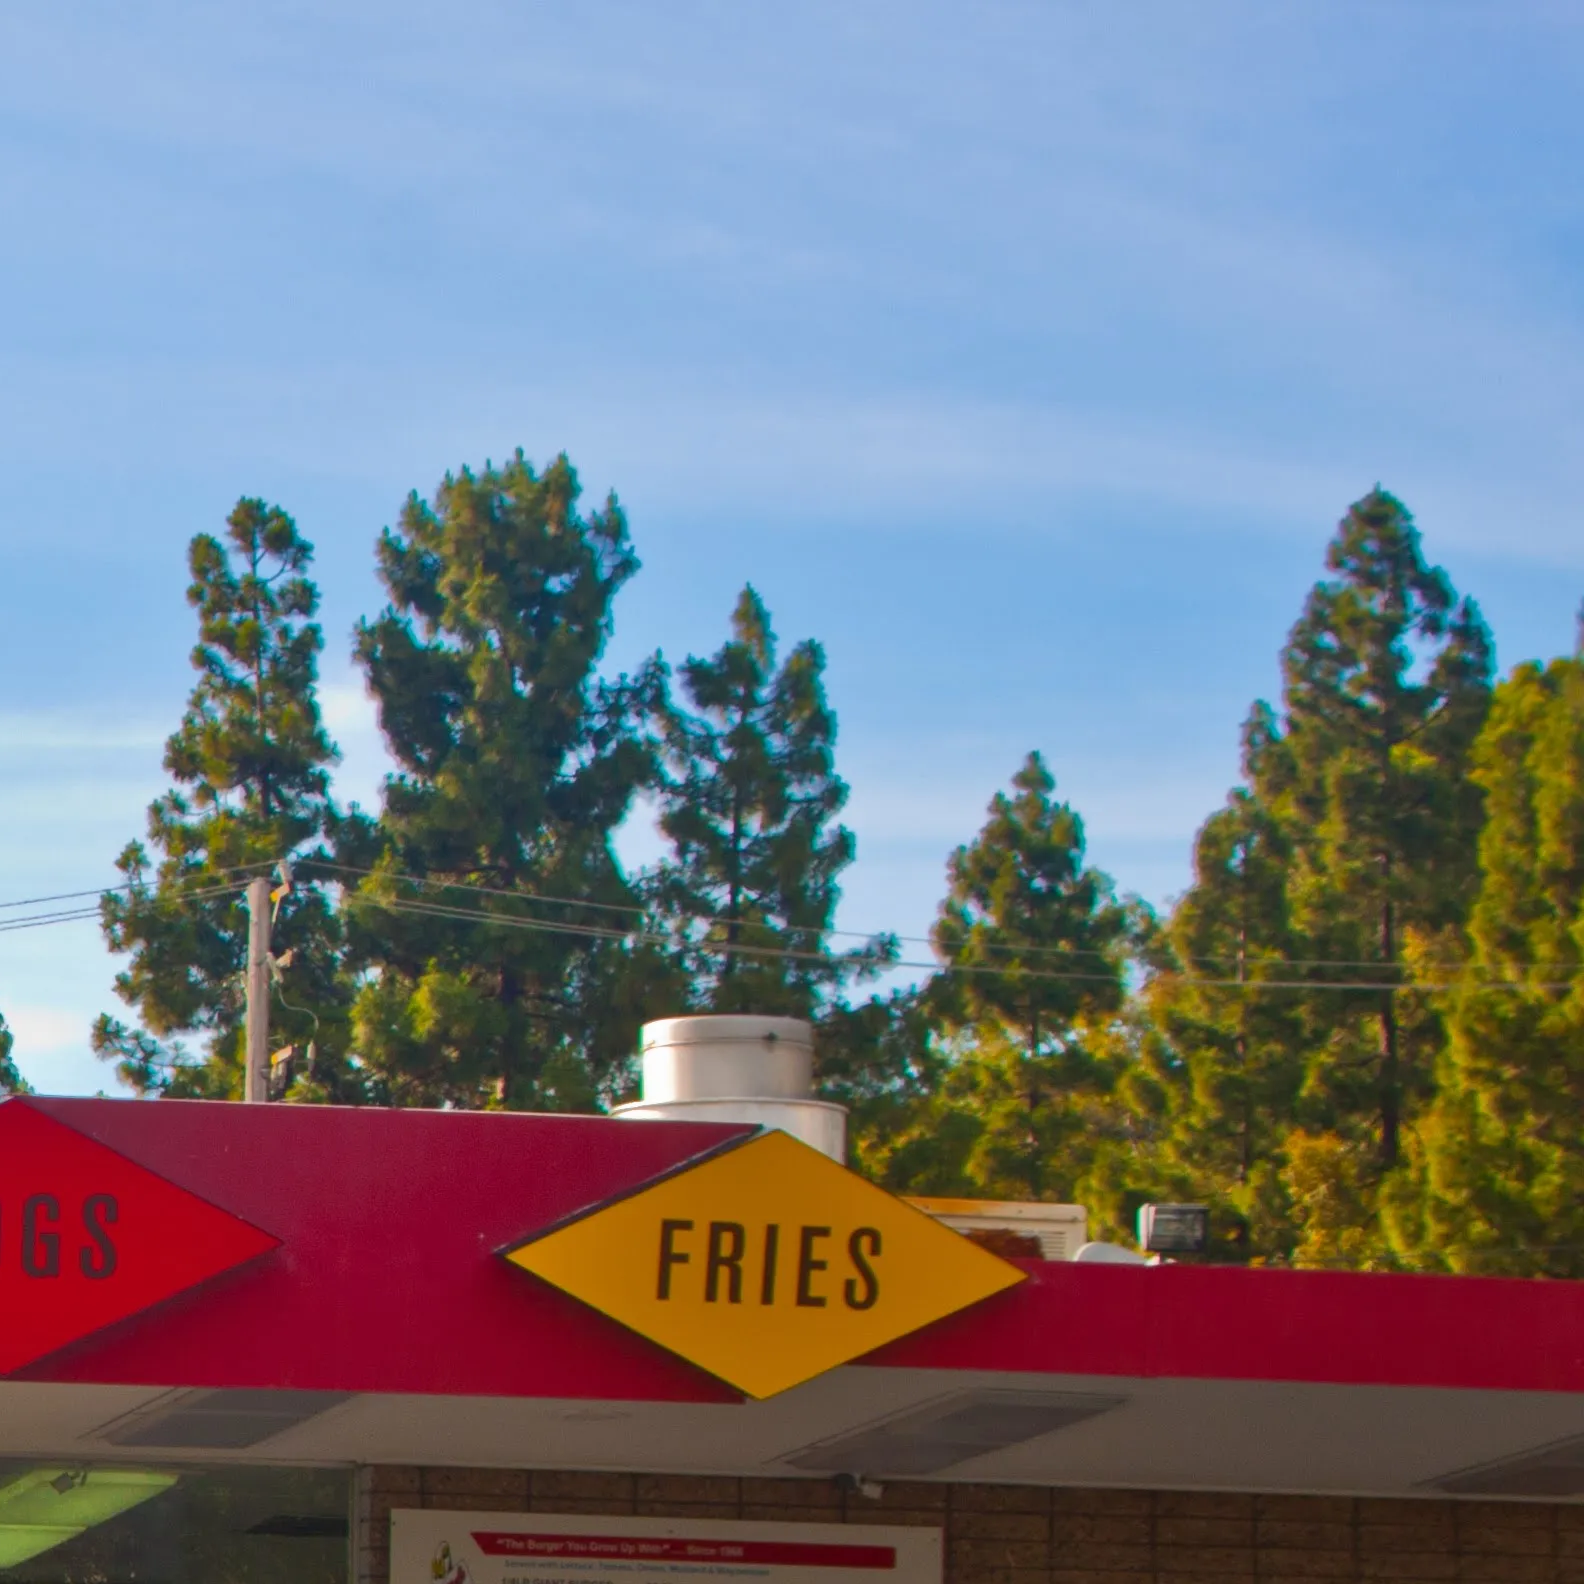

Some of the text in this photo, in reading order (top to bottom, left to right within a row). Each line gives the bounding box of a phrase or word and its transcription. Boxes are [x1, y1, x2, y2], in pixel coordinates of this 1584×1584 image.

[656, 1217, 882, 1311] FRIES
[566, 1541, 587, 1551] You
[622, 1542, 636, 1554] Up
